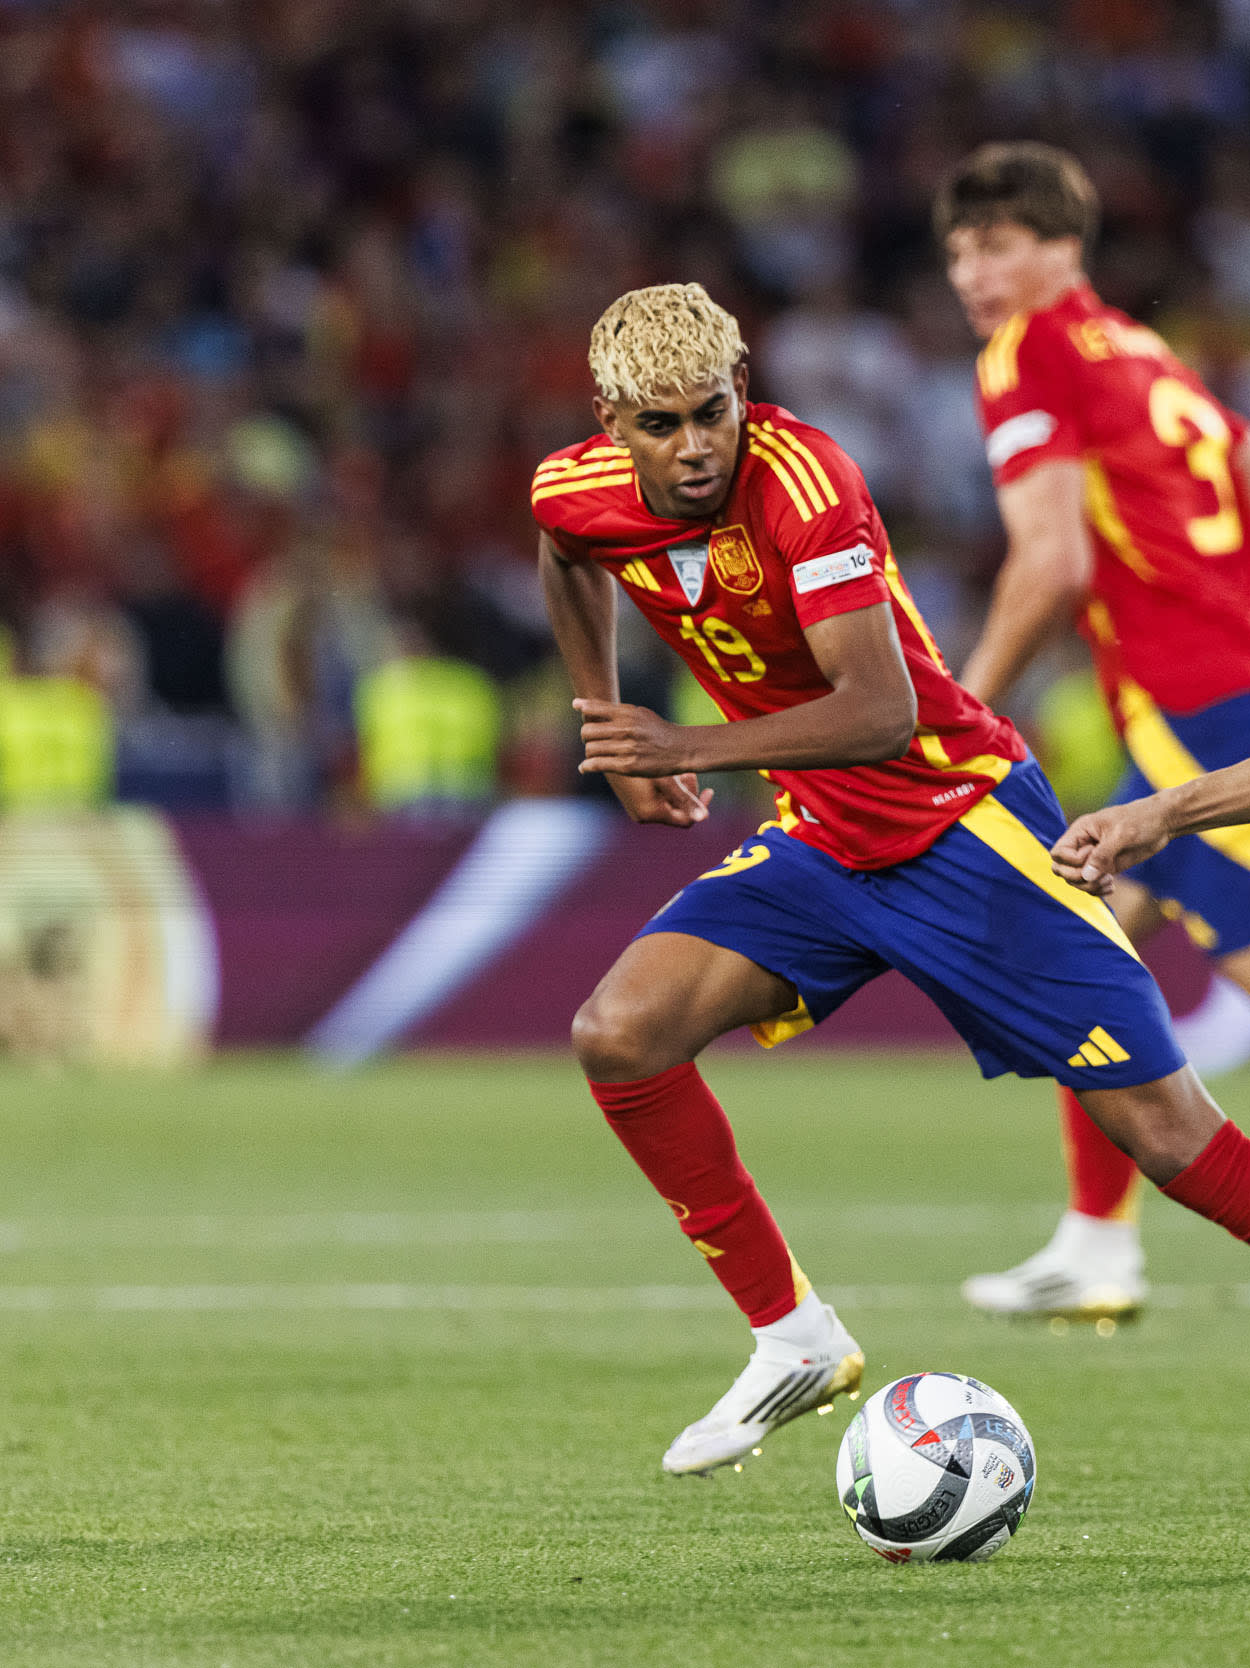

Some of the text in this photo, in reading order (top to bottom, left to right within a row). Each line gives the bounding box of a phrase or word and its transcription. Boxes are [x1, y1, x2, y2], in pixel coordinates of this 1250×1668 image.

[1149, 376, 1244, 556] 3
[680, 615, 766, 683] 19
[901, 1490, 956, 1537] LEAGUE
